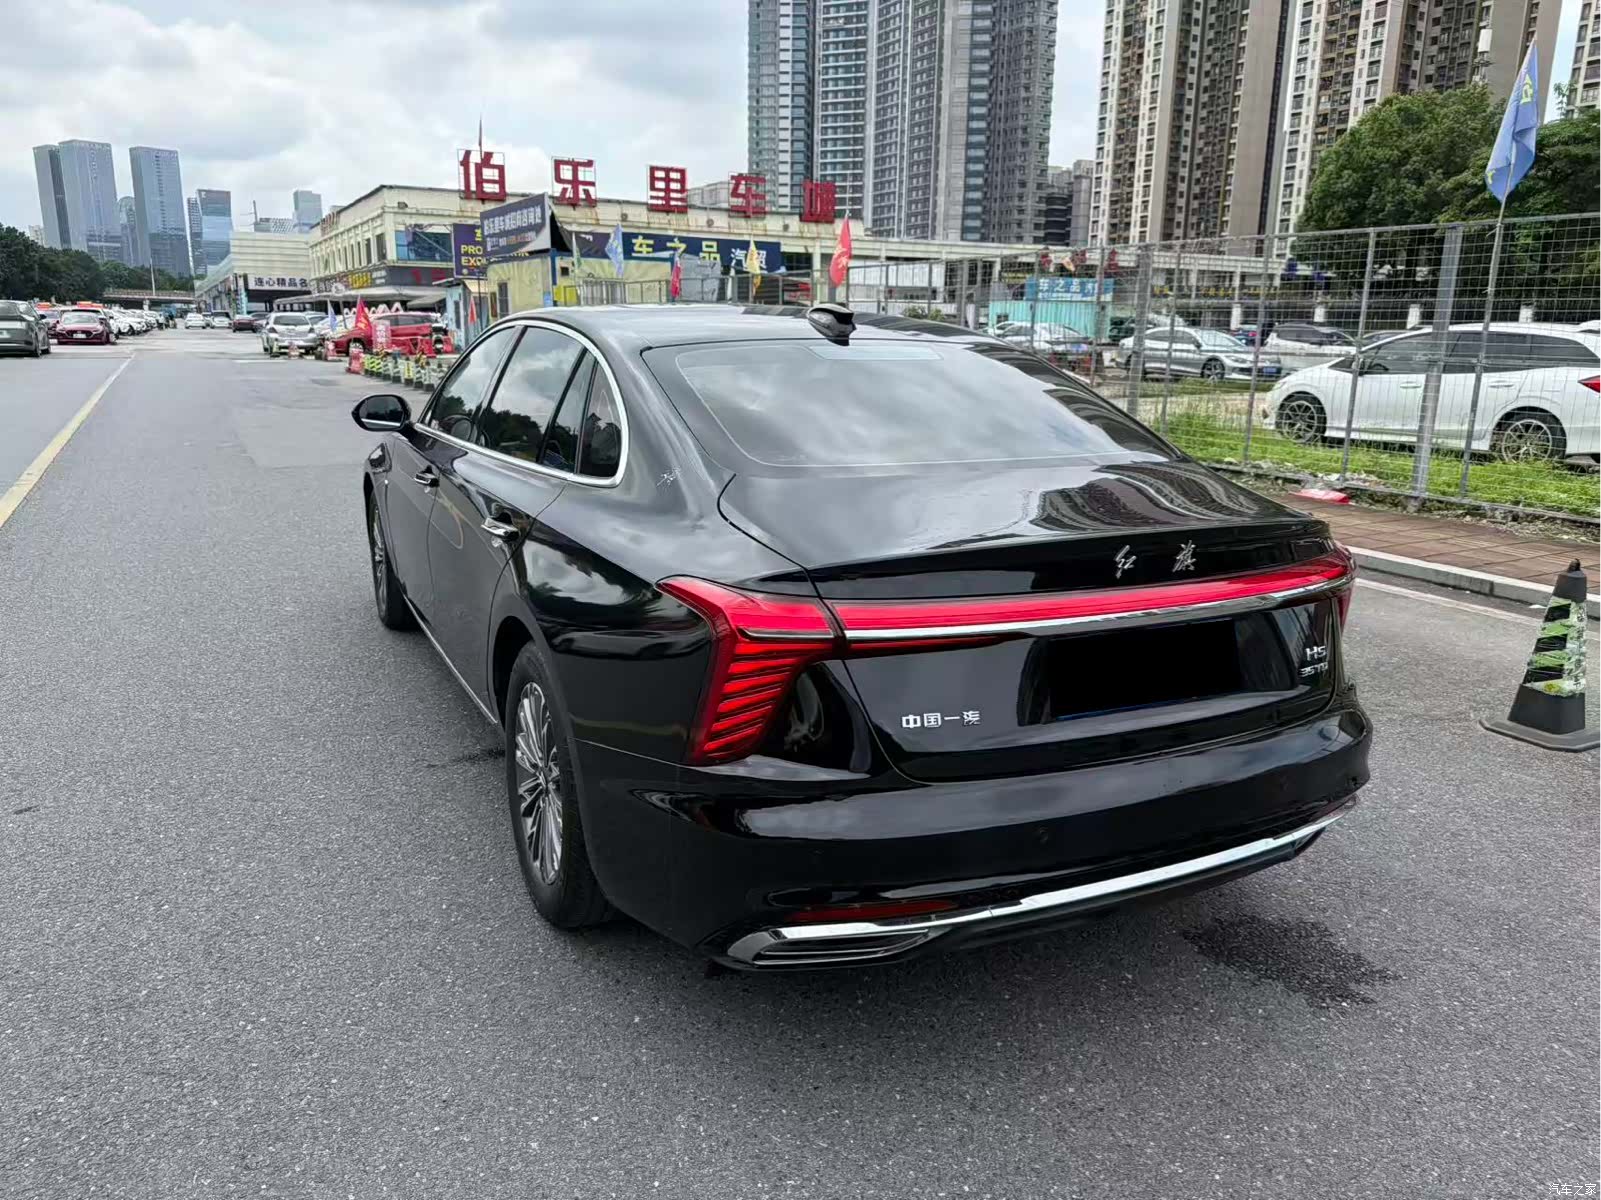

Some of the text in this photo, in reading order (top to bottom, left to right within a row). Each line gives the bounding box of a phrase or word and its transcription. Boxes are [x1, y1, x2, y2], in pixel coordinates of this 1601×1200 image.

[1114, 540, 1197, 579] 红旗
[901, 710, 981, 728] 中国一汽
